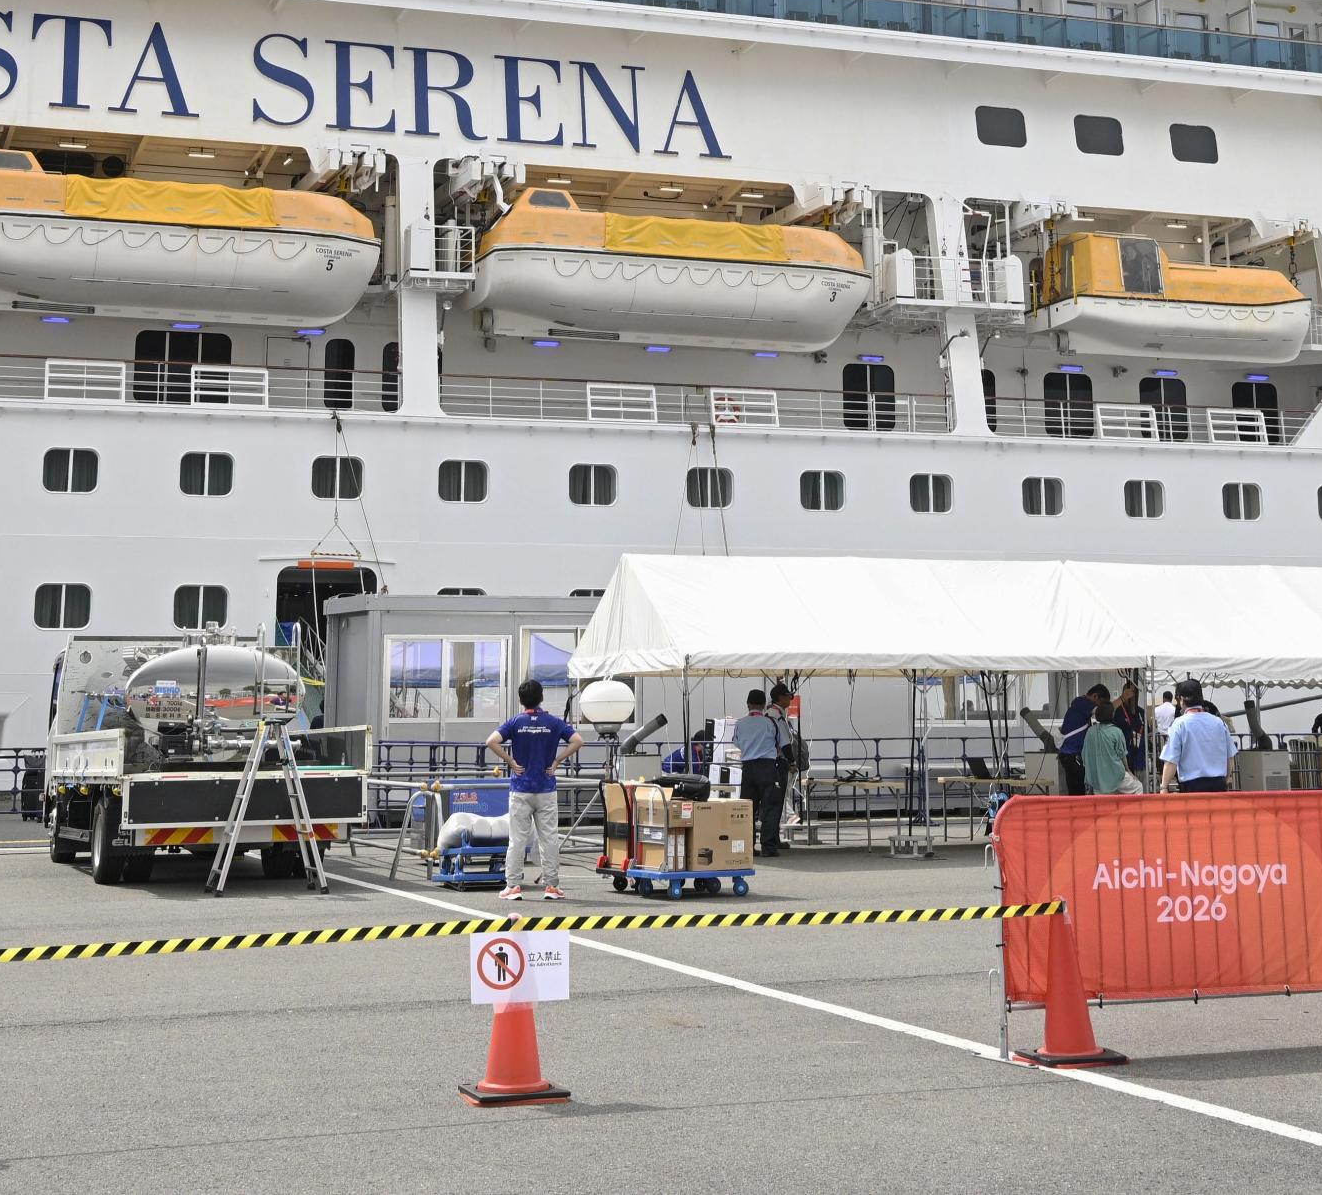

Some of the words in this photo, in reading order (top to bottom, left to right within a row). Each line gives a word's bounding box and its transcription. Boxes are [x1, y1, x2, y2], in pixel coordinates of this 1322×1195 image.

[252, 33, 732, 159] SERENA
[326, 259, 335, 271] 5
[829, 291, 837, 302] 3
[1092, 858, 1288, 895] Aichi-Nagoya
[1156, 894, 1227, 923] 2026
[528, 951, 562, 962] 立入禁止
